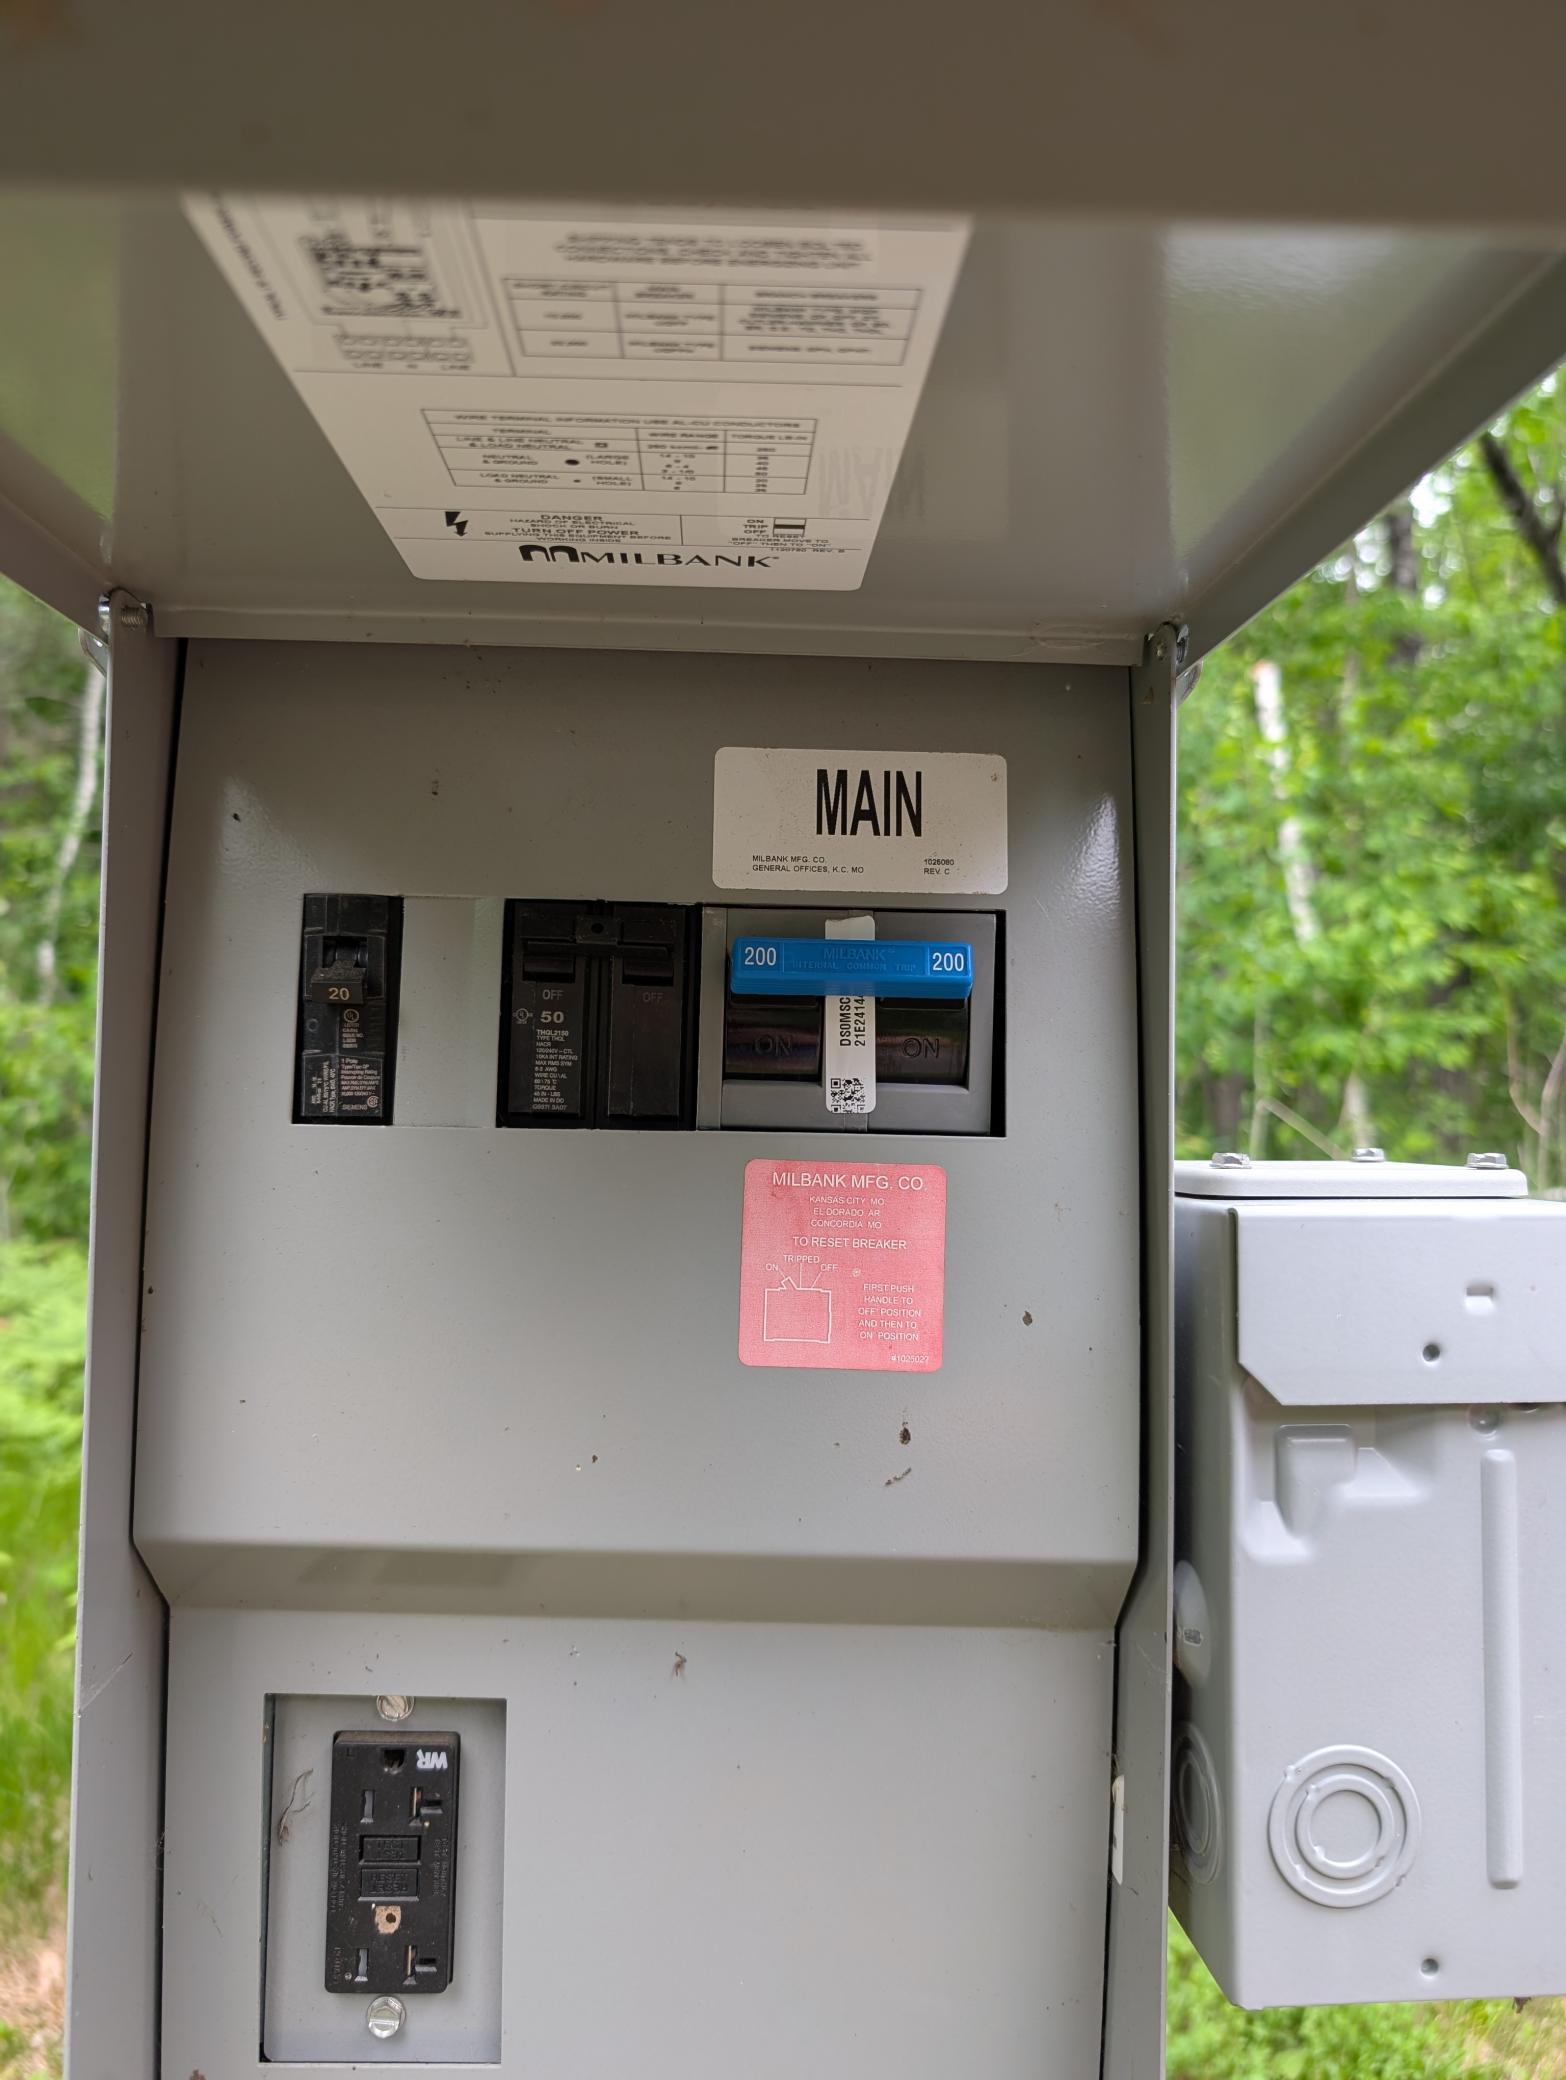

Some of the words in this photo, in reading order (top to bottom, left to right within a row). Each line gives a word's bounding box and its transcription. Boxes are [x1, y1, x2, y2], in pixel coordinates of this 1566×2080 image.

[454, 413, 487, 421] WIRE
[490, 414, 552, 423] TERMINAL
[555, 416, 640, 425] INFORMATION
[711, 420, 799, 429] CONDUCTORS
[491, 427, 552, 436] TERMINAL
[648, 431, 677, 439] WIRE
[680, 432, 719, 440] RANGE
[540, 514, 603, 522] DANGER
[484, 530, 542, 538] SUPPLYING
[511, 527, 552, 535] TURN
[743, 528, 768, 536] OFF
[580, 552, 772, 568] MILBANK
[816, 768, 923, 837] MAIN
[751, 854, 788, 863] MILBANK
[751, 864, 791, 872] GENERAL
[792, 865, 829, 875] OFFICES,
[851, 866, 865, 874] MO
[943, 868, 951, 876] C
[743, 946, 777, 967] 200
[932, 952, 965, 972] 200
[846, 962, 887, 971] COMMON
[896, 964, 917, 973] TRIP
[328, 987, 350, 1001] 20
[542, 989, 564, 1000] OFF
[642, 991, 664, 1002] OFF
[540, 1010, 565, 1024] 50
[755, 1034, 792, 1057] ON
[901, 1036, 940, 1059] ON
[772, 1171, 847, 1188] MILBANK
[851, 1174, 894, 1190] MFG.
[809, 1195, 844, 1204] KANSAS
[846, 1196, 866, 1205] CITY
[813, 1207, 825, 1216] EL
[826, 1208, 864, 1217] DORADO
[868, 1209, 881, 1217] AR
[810, 1219, 864, 1228] CONCORDIA
[867, 1221, 882, 1229] MO
[792, 1236, 808, 1247] TO
[811, 1236, 849, 1248] RESET
[852, 1238, 908, 1250] BREAKER
[783, 1254, 821, 1264] TRIPPED
[765, 1263, 779, 1271] ON
[820, 1264, 839, 1272] OFF
[863, 1283, 889, 1292] FIRST
[890, 1284, 915, 1293] PUSH
[864, 1295, 899, 1304] HANDLE
[900, 1296, 914, 1305] TO
[880, 1308, 922, 1317] POSITION
[858, 1319, 878, 1328] AND
[880, 1320, 903, 1329] THEN
[905, 1321, 918, 1330] TO
[877, 1332, 919, 1341] POSITION
[416, 1749, 448, 1770] WR
